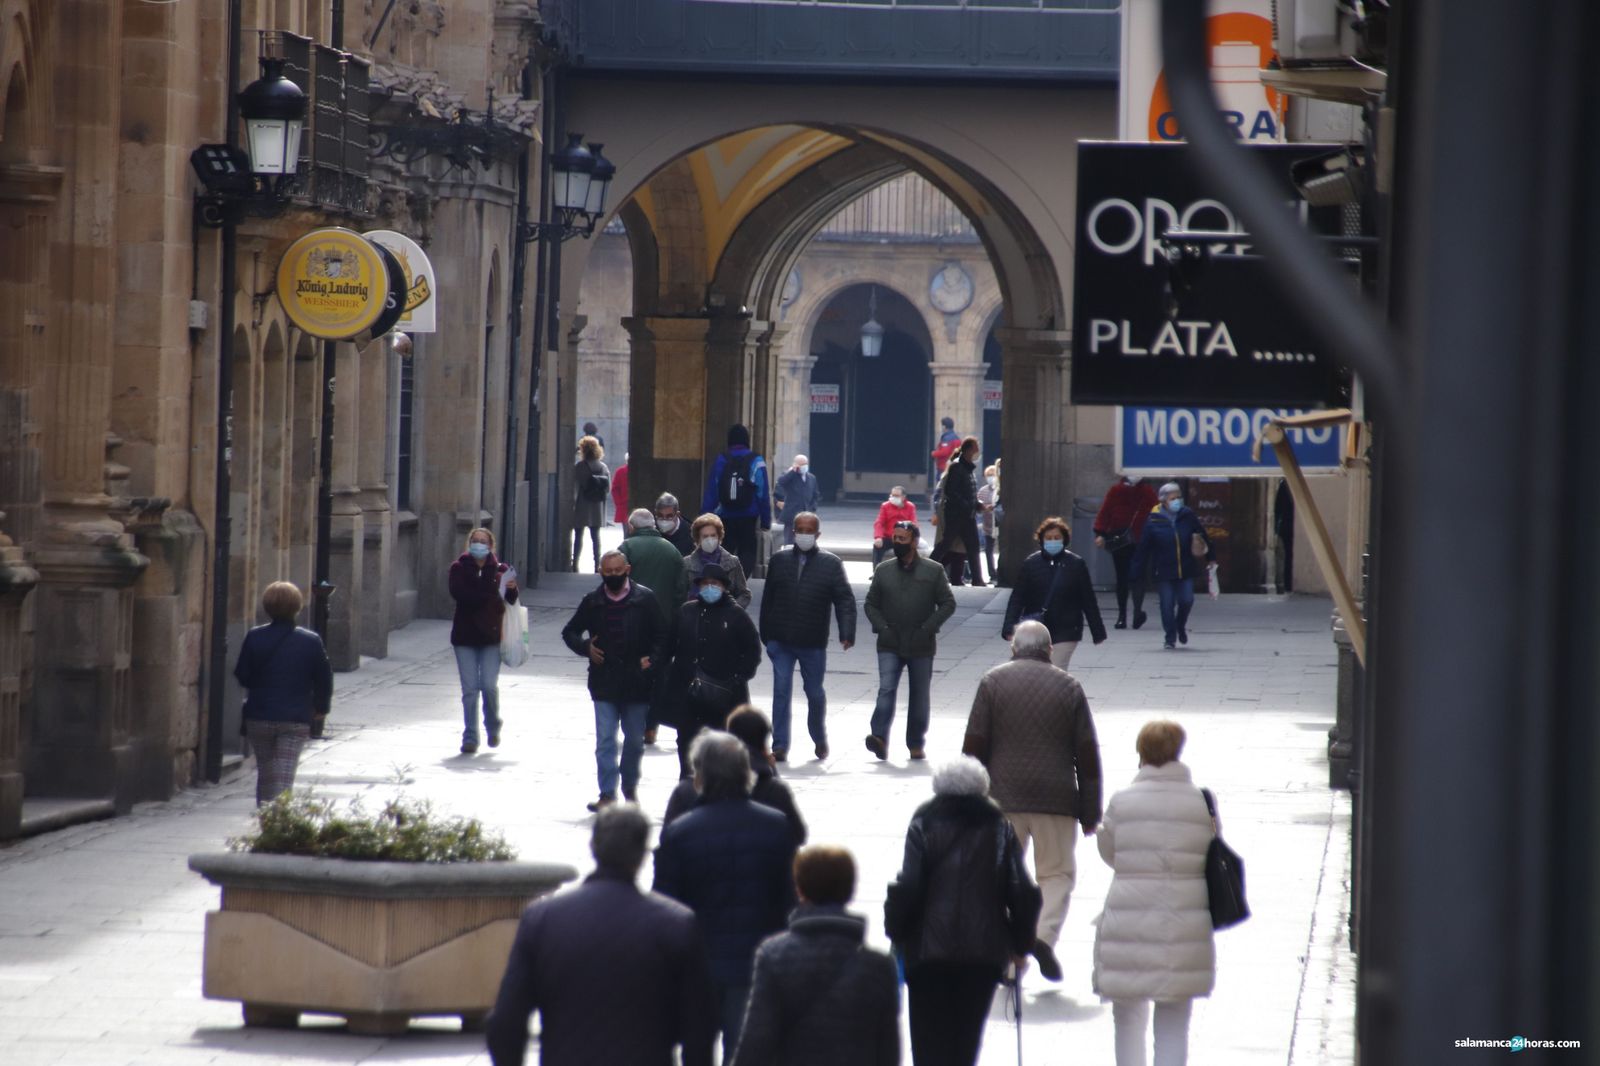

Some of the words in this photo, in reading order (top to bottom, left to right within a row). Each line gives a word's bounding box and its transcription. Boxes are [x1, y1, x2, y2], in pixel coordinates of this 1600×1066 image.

[295, 279, 327, 297] König
[326, 281, 368, 301] Ludwig
[304, 297, 360, 308] WEISSBIER
[1091, 319, 1238, 357] PLATA
[1136, 408, 1333, 445] MOROCHO
